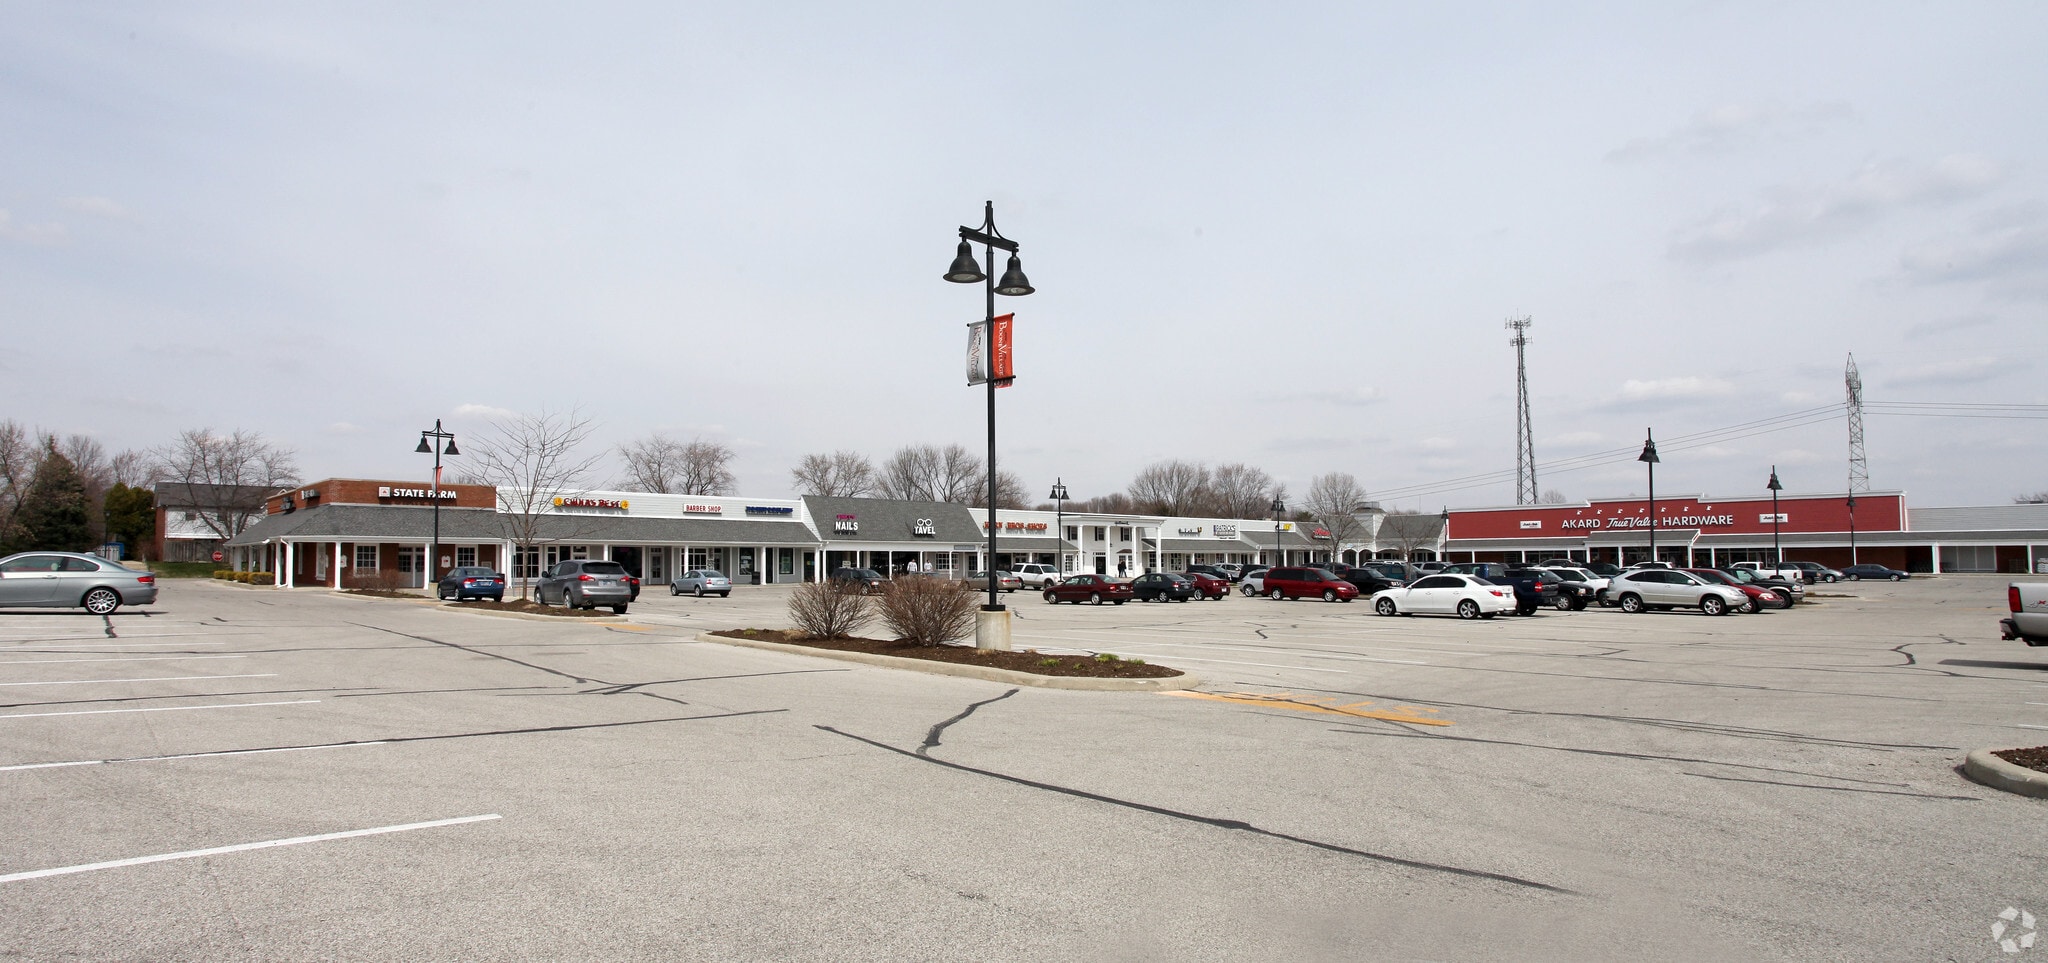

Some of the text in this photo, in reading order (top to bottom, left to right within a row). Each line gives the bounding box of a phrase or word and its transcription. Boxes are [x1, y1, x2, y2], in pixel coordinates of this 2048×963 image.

[393, 488, 424, 498] STATE
[686, 504, 707, 512] BARBER
[835, 521, 859, 531] NAILS
[1561, 518, 1601, 528] AKARD
[1662, 514, 1734, 526] HARDWARE
[914, 526, 936, 535] TAVEL
